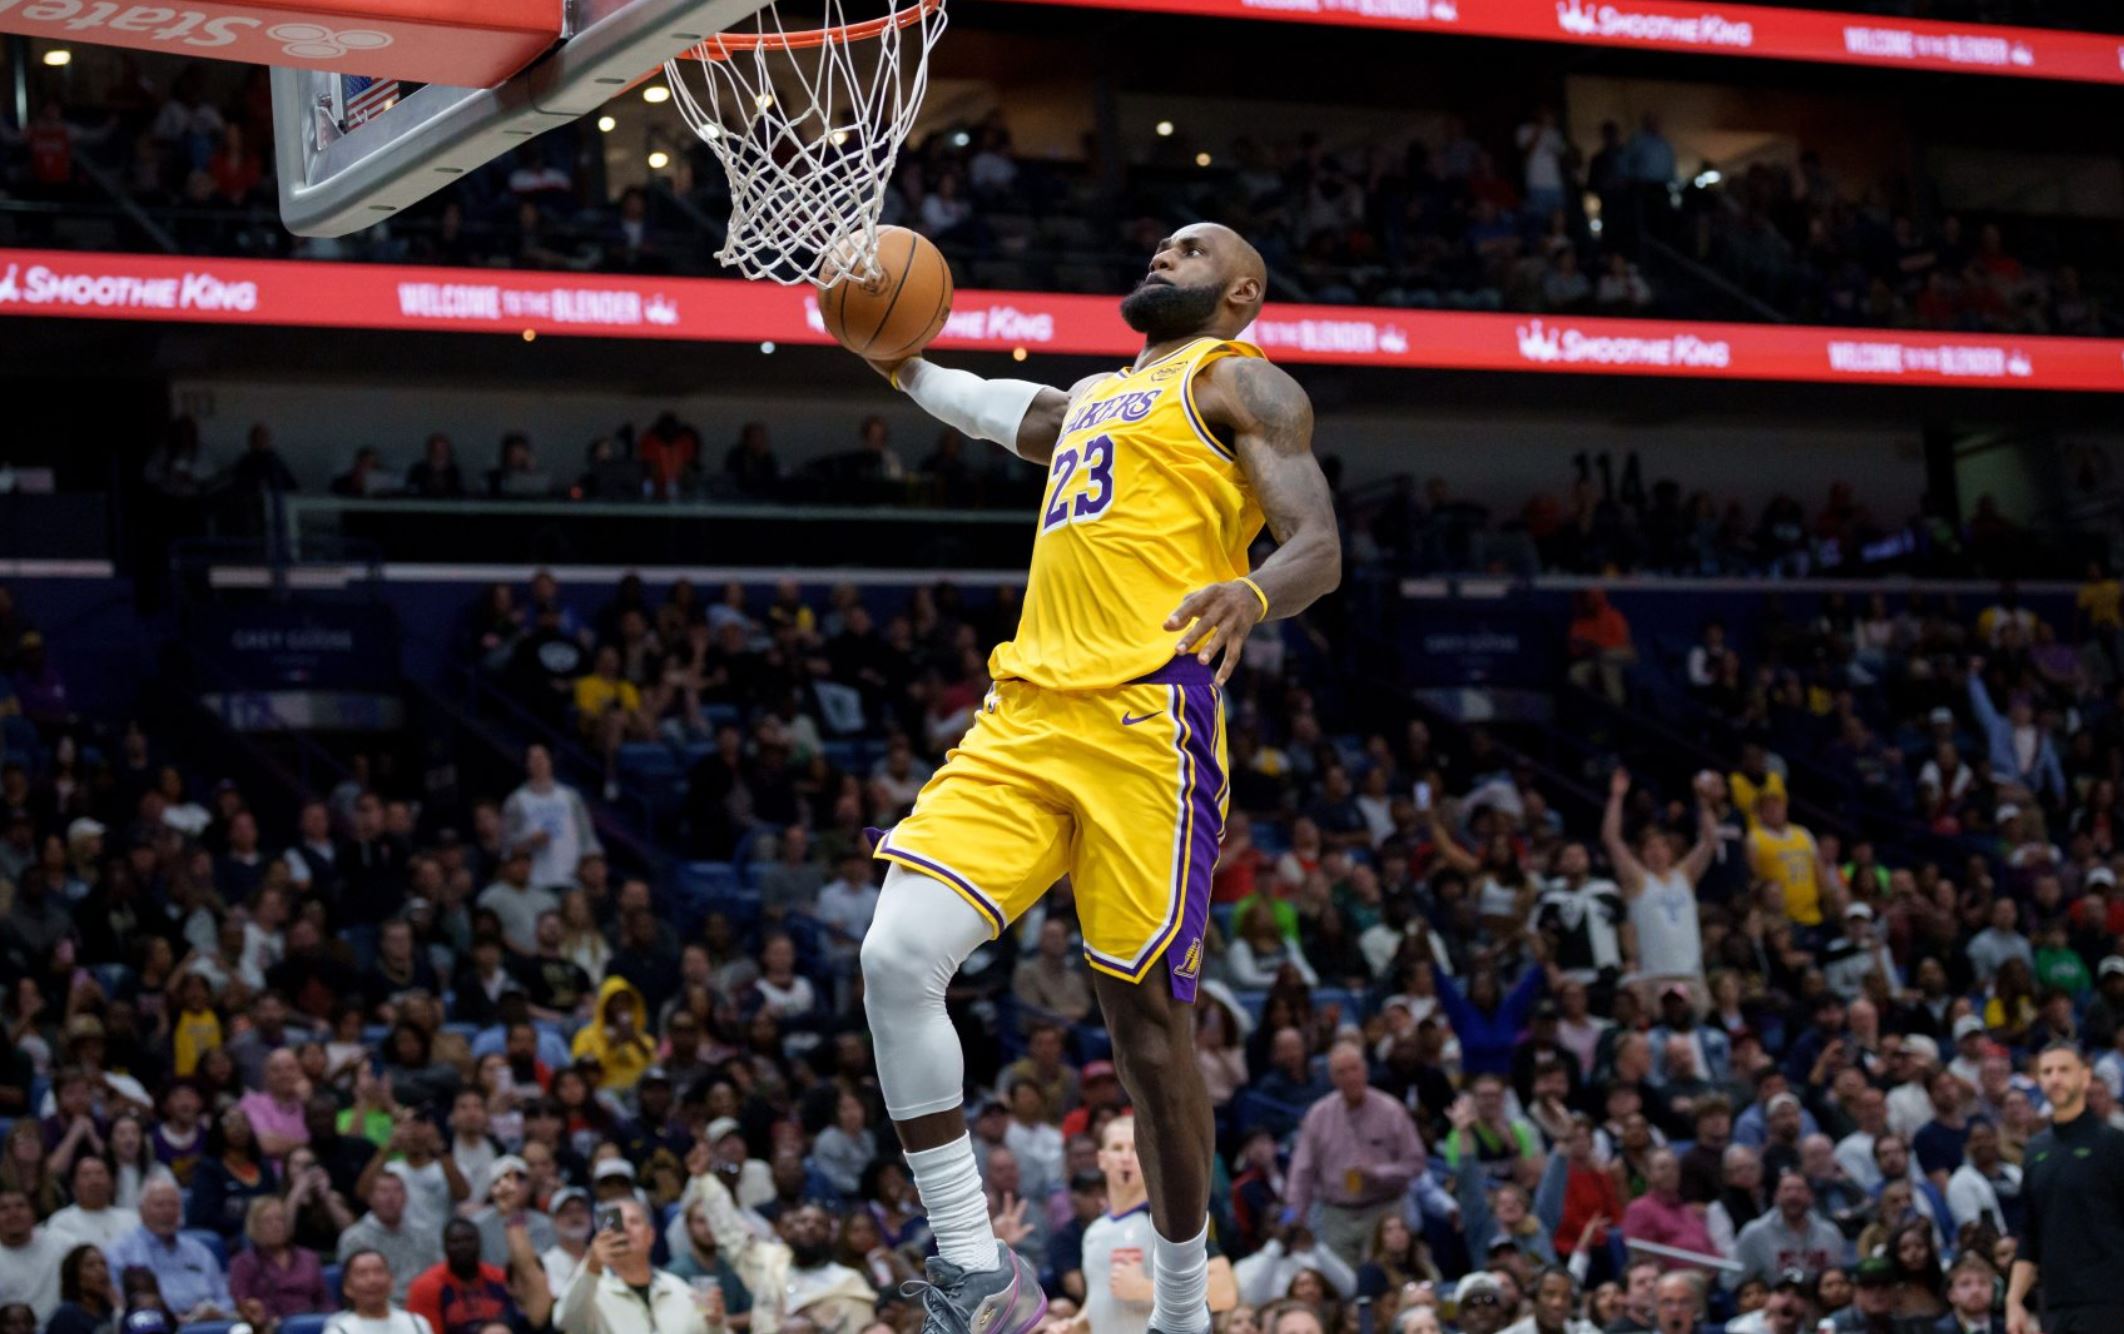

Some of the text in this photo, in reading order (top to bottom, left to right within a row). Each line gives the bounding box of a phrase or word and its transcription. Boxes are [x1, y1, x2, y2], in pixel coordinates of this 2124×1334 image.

[22, 0, 262, 46] State
[24, 266, 179, 308] SMOOTHIE
[1041, 432, 1115, 536] 23
